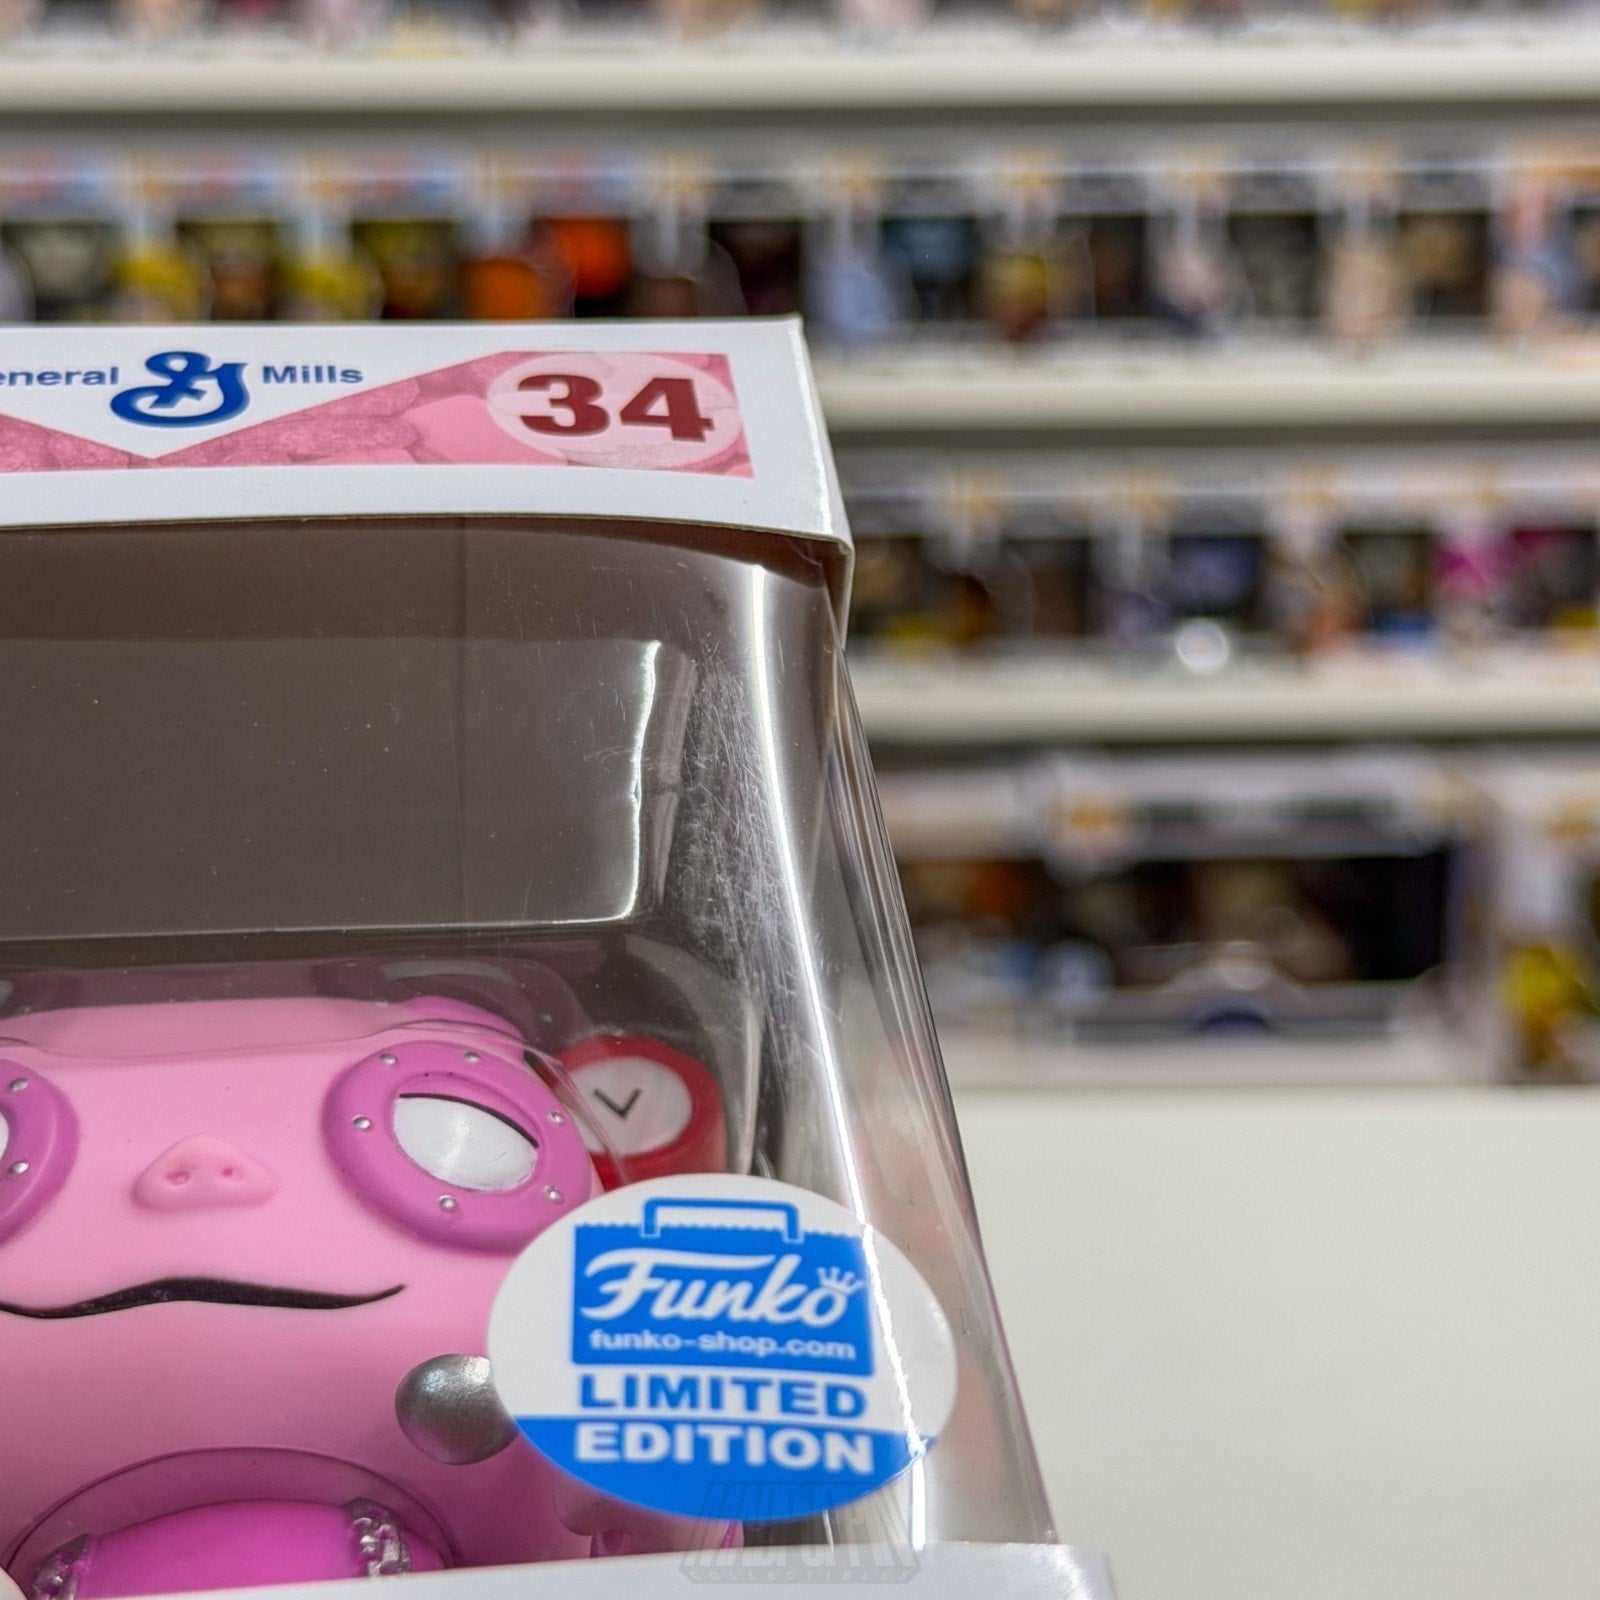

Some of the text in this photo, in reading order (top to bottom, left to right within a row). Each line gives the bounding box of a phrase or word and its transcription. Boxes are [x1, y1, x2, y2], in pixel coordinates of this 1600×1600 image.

[0, 366, 119, 386] neral
[262, 365, 364, 384] Mills
[517, 373, 716, 443] 34
[580, 1247, 850, 1328] Funko
[589, 1327, 857, 1361] funko-shop.com
[578, 1373, 869, 1420] LIMITED
[574, 1421, 875, 1475] EDITION
